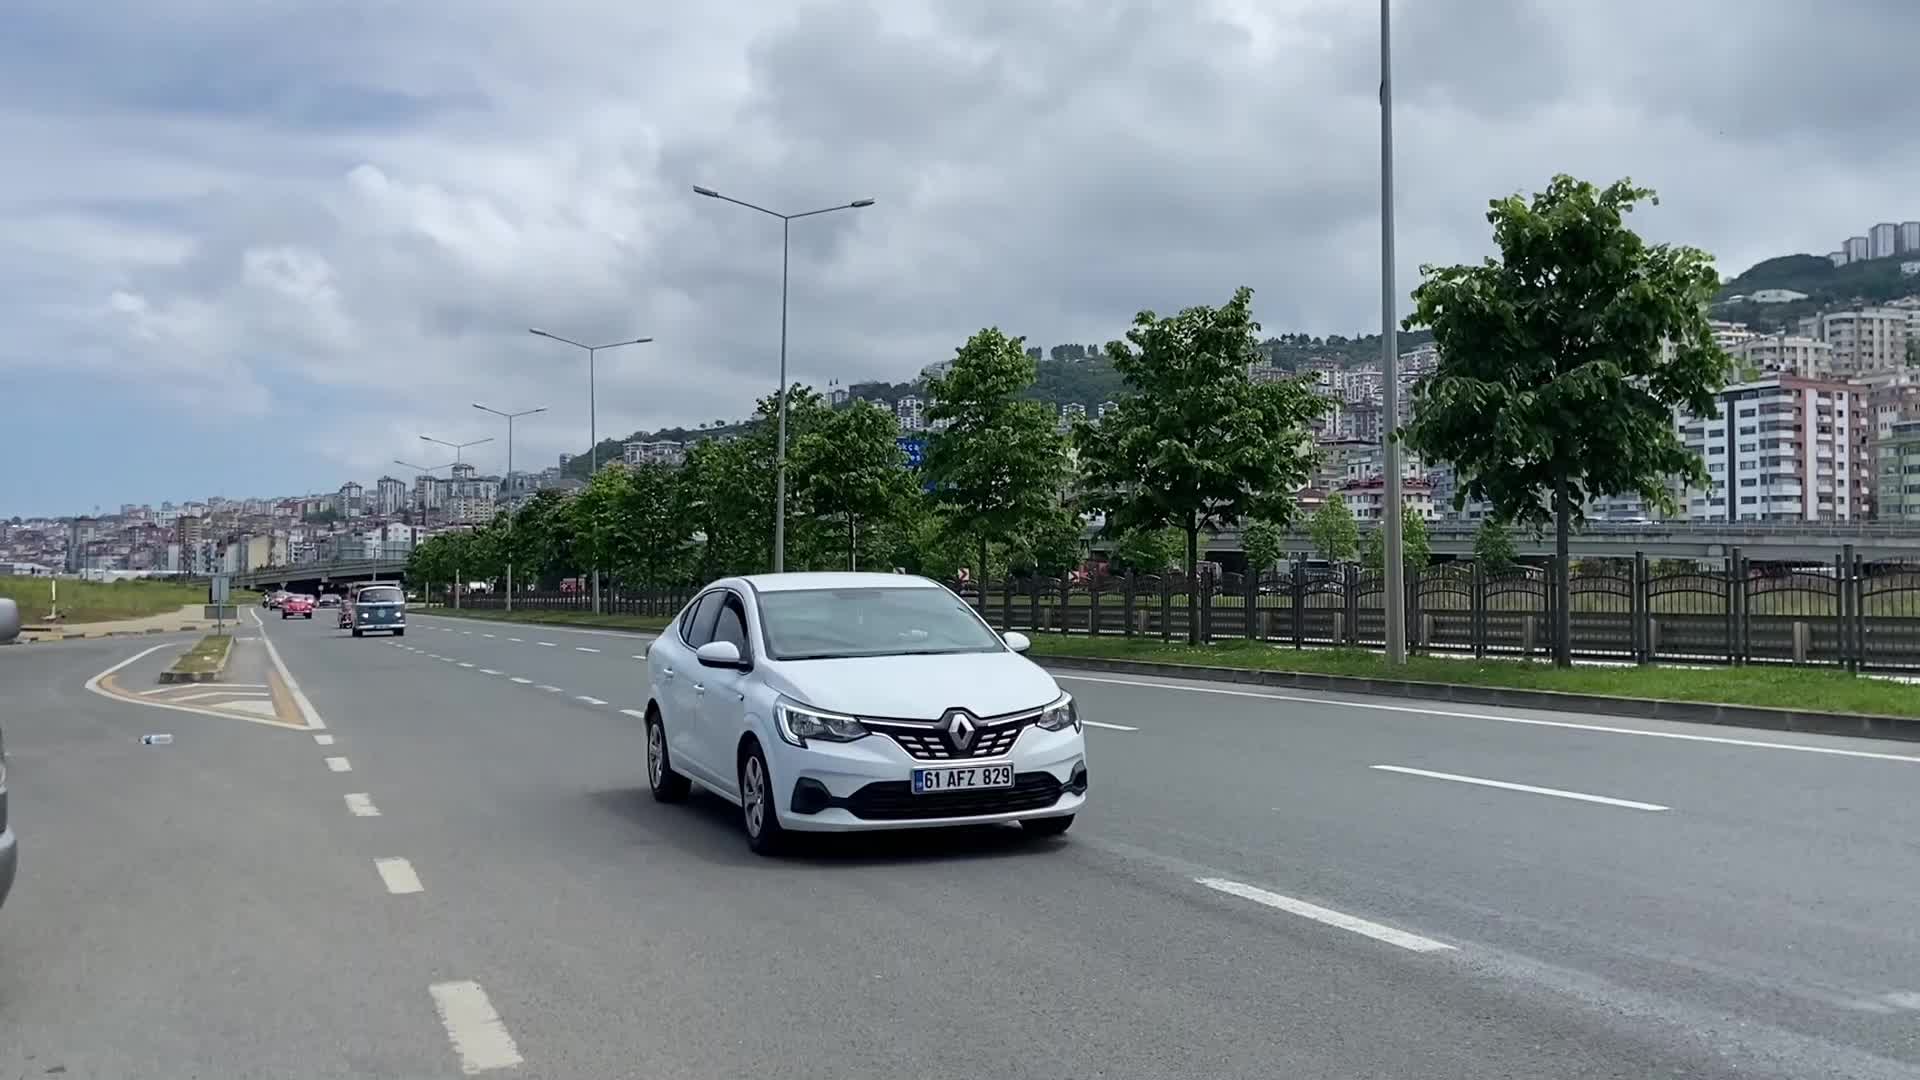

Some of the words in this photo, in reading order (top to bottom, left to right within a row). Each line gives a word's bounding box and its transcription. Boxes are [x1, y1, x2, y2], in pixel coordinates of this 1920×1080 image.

[924, 771, 940, 789] 61
[947, 769, 976, 788] AFZ
[983, 767, 1010, 785] 829
